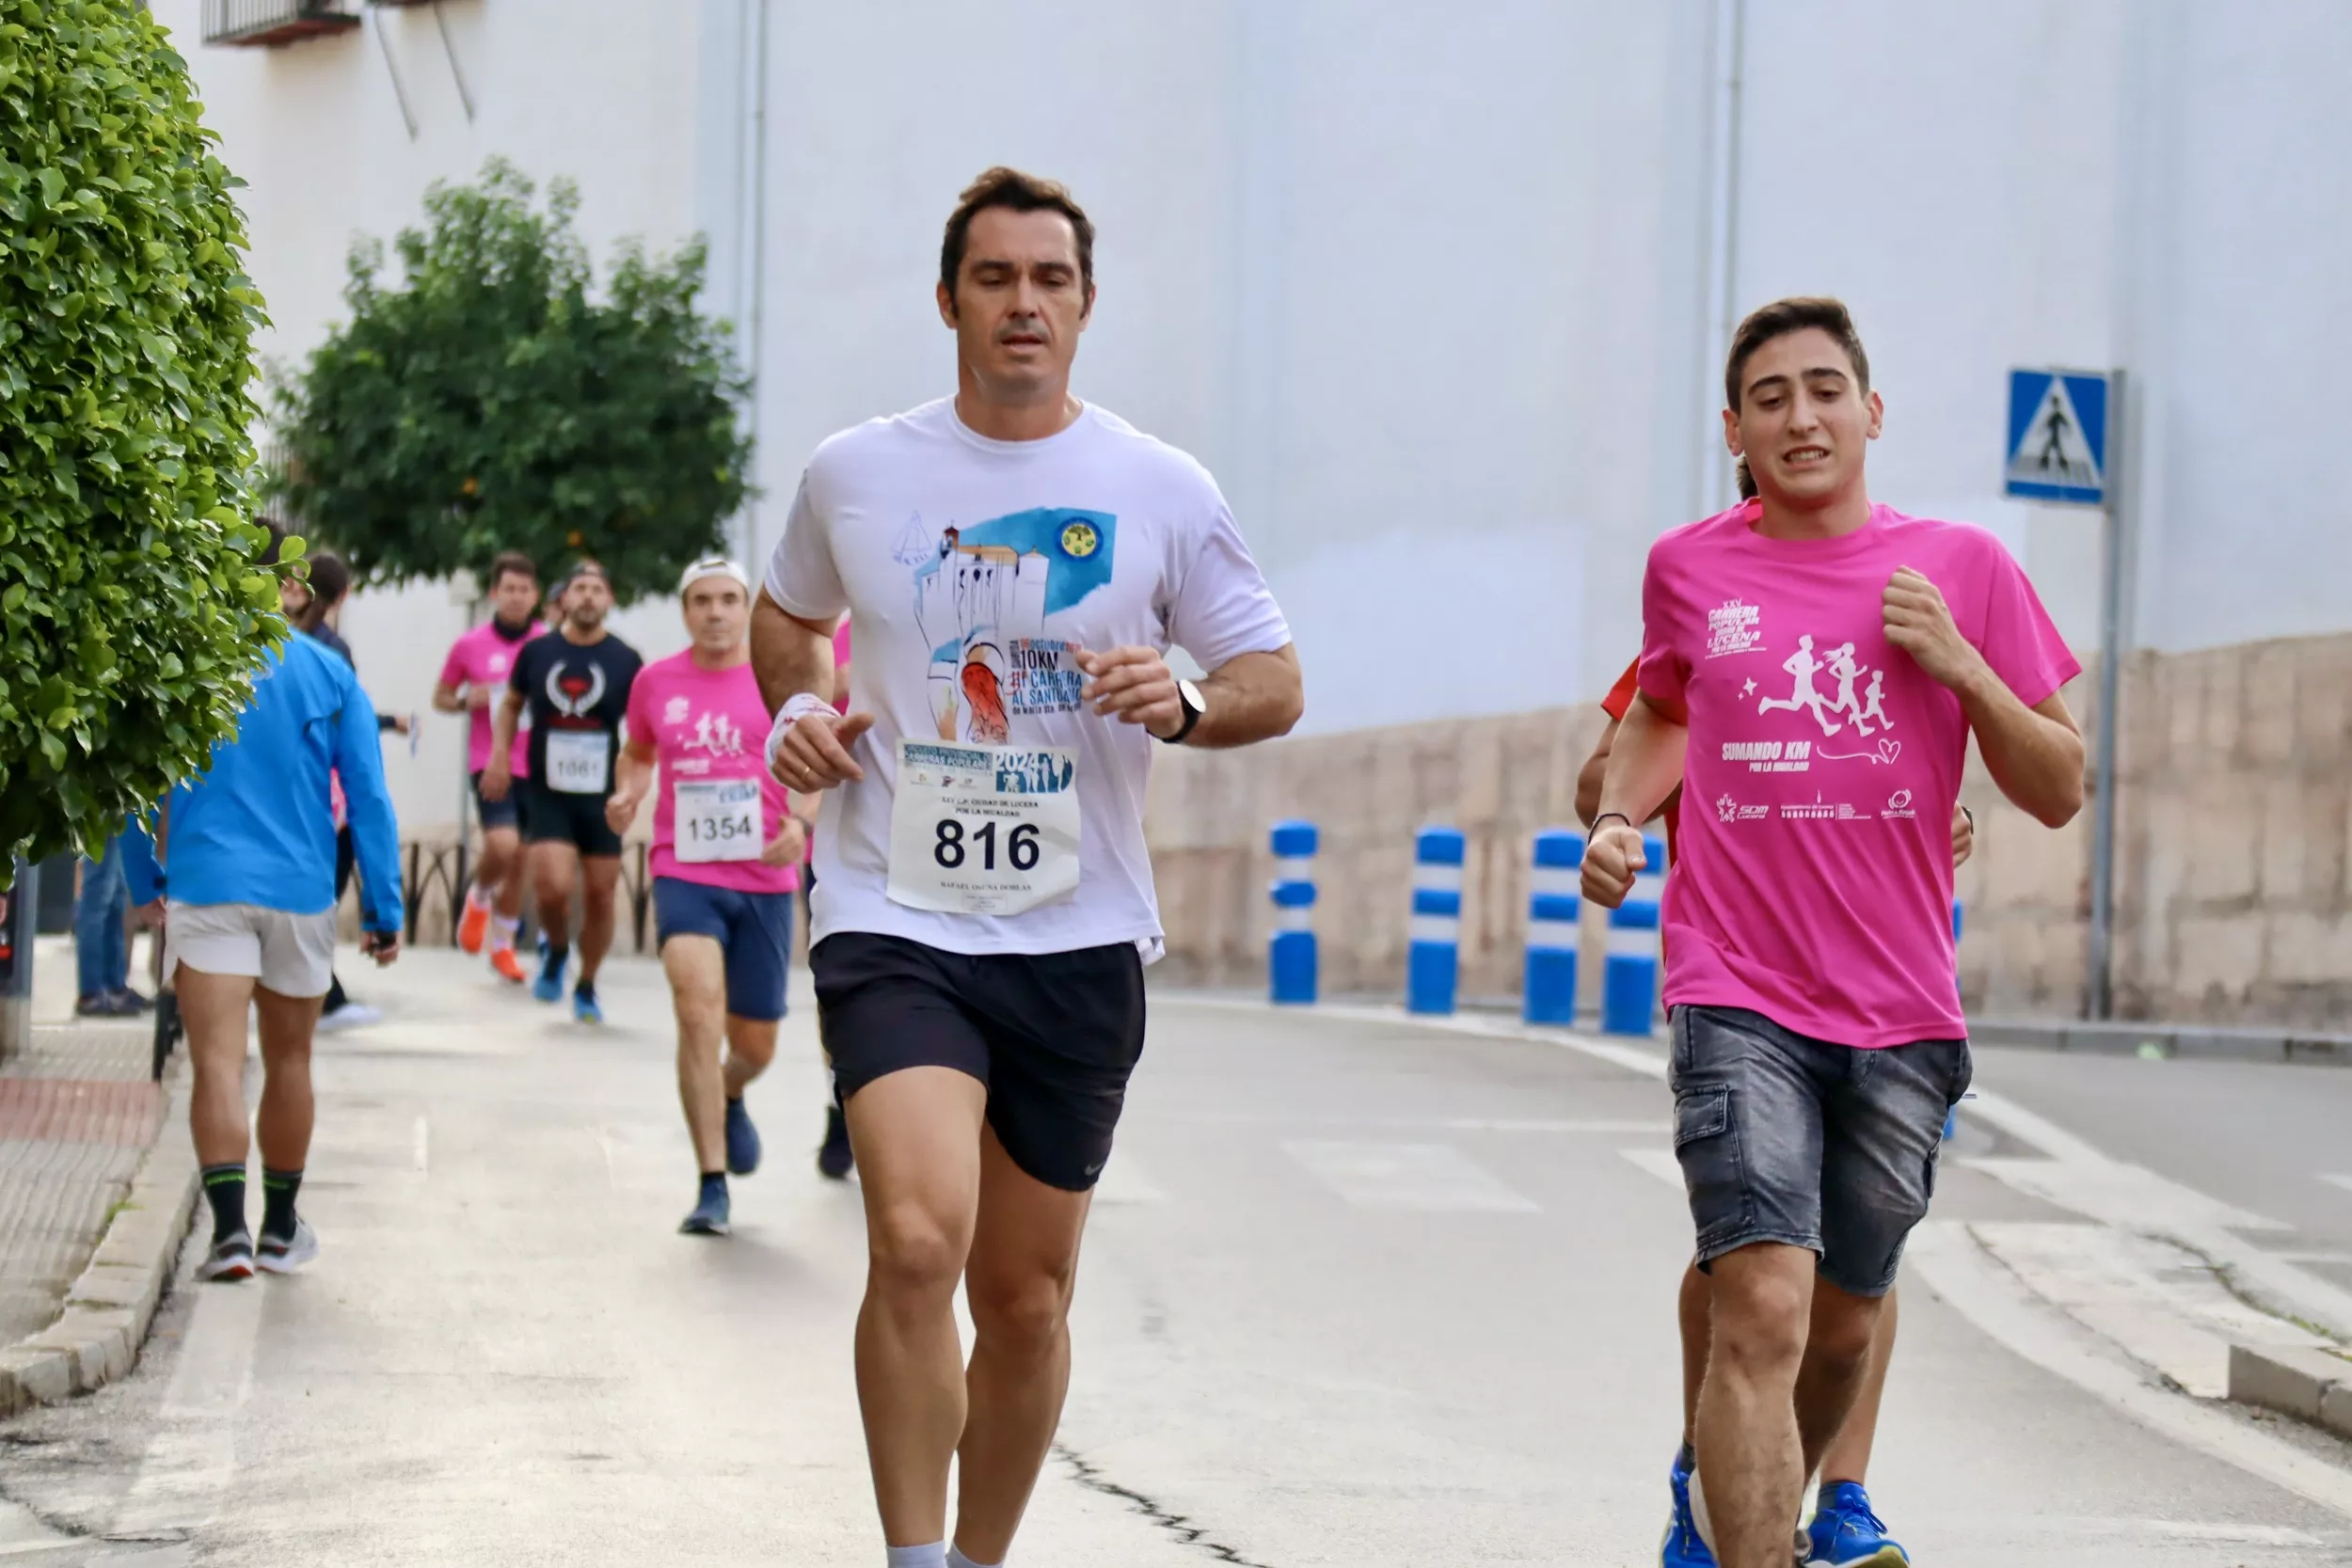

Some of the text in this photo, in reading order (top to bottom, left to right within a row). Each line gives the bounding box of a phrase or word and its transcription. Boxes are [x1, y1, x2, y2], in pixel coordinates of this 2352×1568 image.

[1707, 631, 1760, 649] LUCENA
[1012, 689, 1025, 705] AL
[1722, 740, 1811, 761] SUMANDO KM
[994, 752, 1040, 772] 2024
[1762, 762, 1772, 772] LA
[688, 816, 752, 842] 1354
[934, 819, 1040, 871] 816
